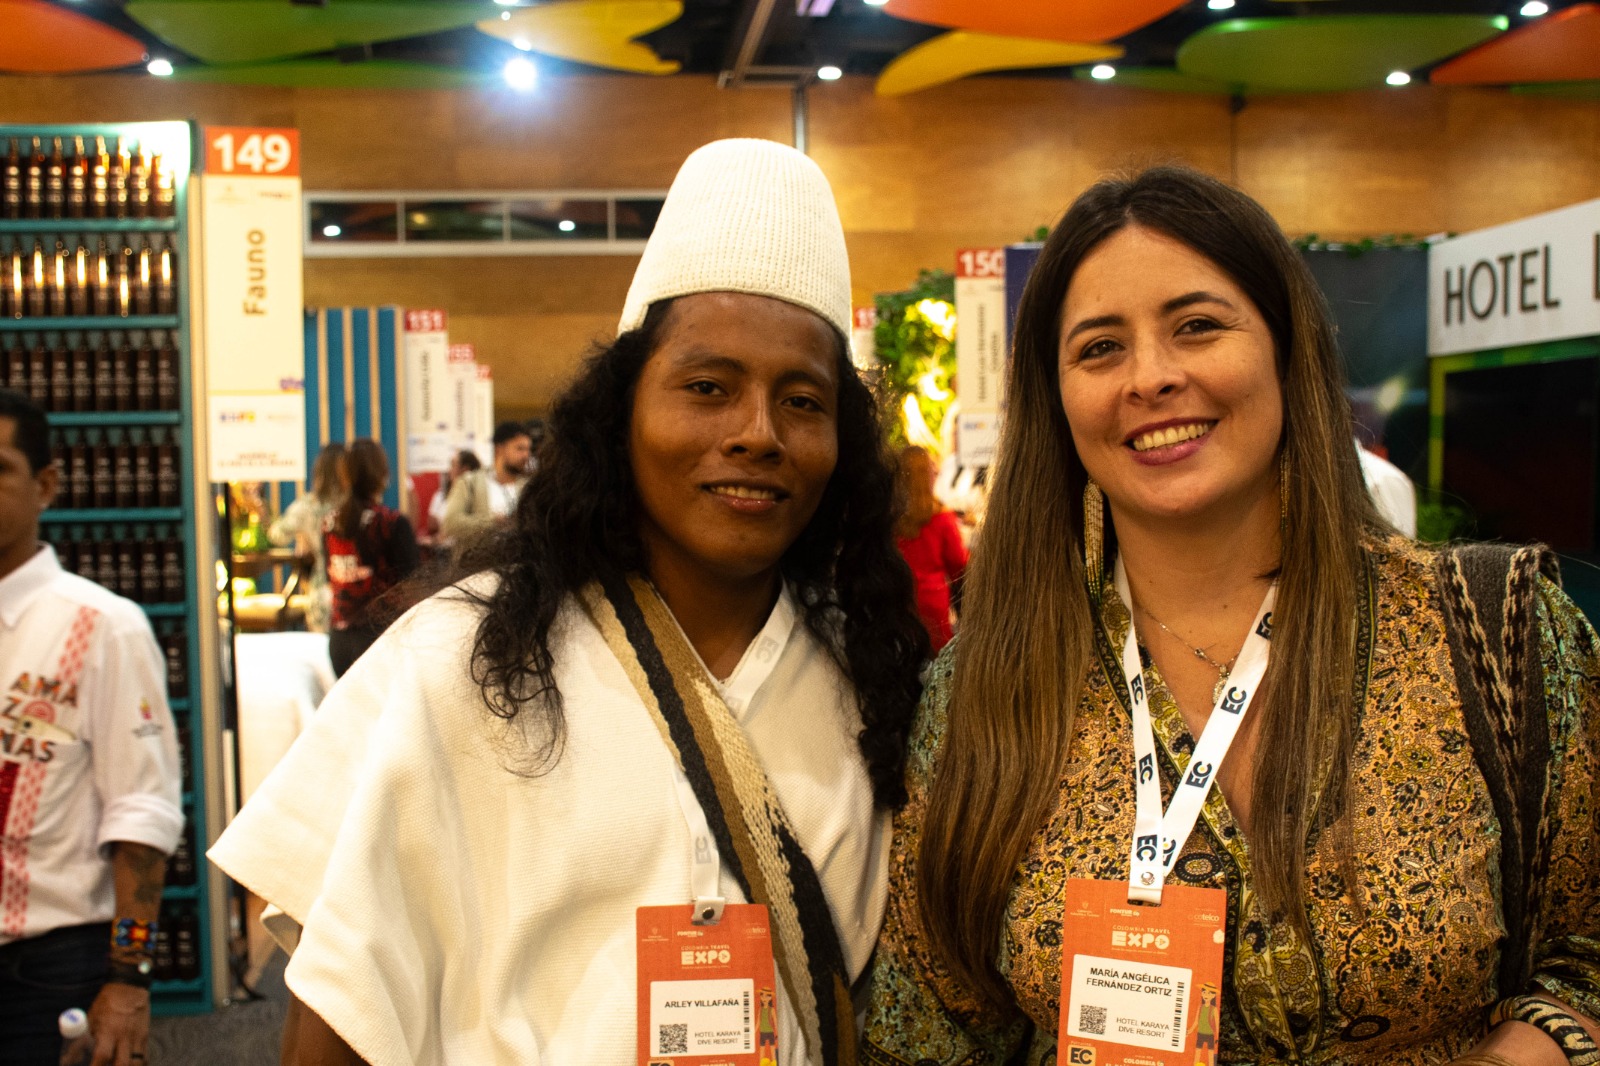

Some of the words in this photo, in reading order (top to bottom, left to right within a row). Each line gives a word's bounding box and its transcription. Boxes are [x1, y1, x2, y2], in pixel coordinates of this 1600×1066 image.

[213, 134, 291, 172] 149
[244, 229, 266, 316] Fauno
[1444, 243, 1560, 326] HOTEL
[754, 635, 780, 665] EC
[10, 672, 78, 708] AMA
[1130, 673, 1144, 706] EC
[1220, 686, 1247, 715] EC
[1138, 753, 1154, 785] EC
[1185, 760, 1213, 788] EC
[694, 835, 713, 864] EC
[1136, 834, 1158, 862] EC
[1112, 930, 1170, 950] EXPO
[681, 950, 731, 966] EXPO
[1086, 978, 1142, 993] FERNÁNDEZ
[1144, 985, 1172, 997] ORTIZ
[1090, 967, 1119, 979] MARÍA
[1121, 972, 1170, 985] ANGÉLICA
[664, 1000, 692, 1008] ARLEY
[694, 998, 739, 1007] VILLAFAÑA
[1116, 1017, 1138, 1026] HOTEL
[1140, 1021, 1170, 1030] KARAYA
[1118, 1026, 1135, 1034] DIVE
[1136, 1029, 1166, 1038] RESORT
[1070, 1046, 1093, 1065] EC
